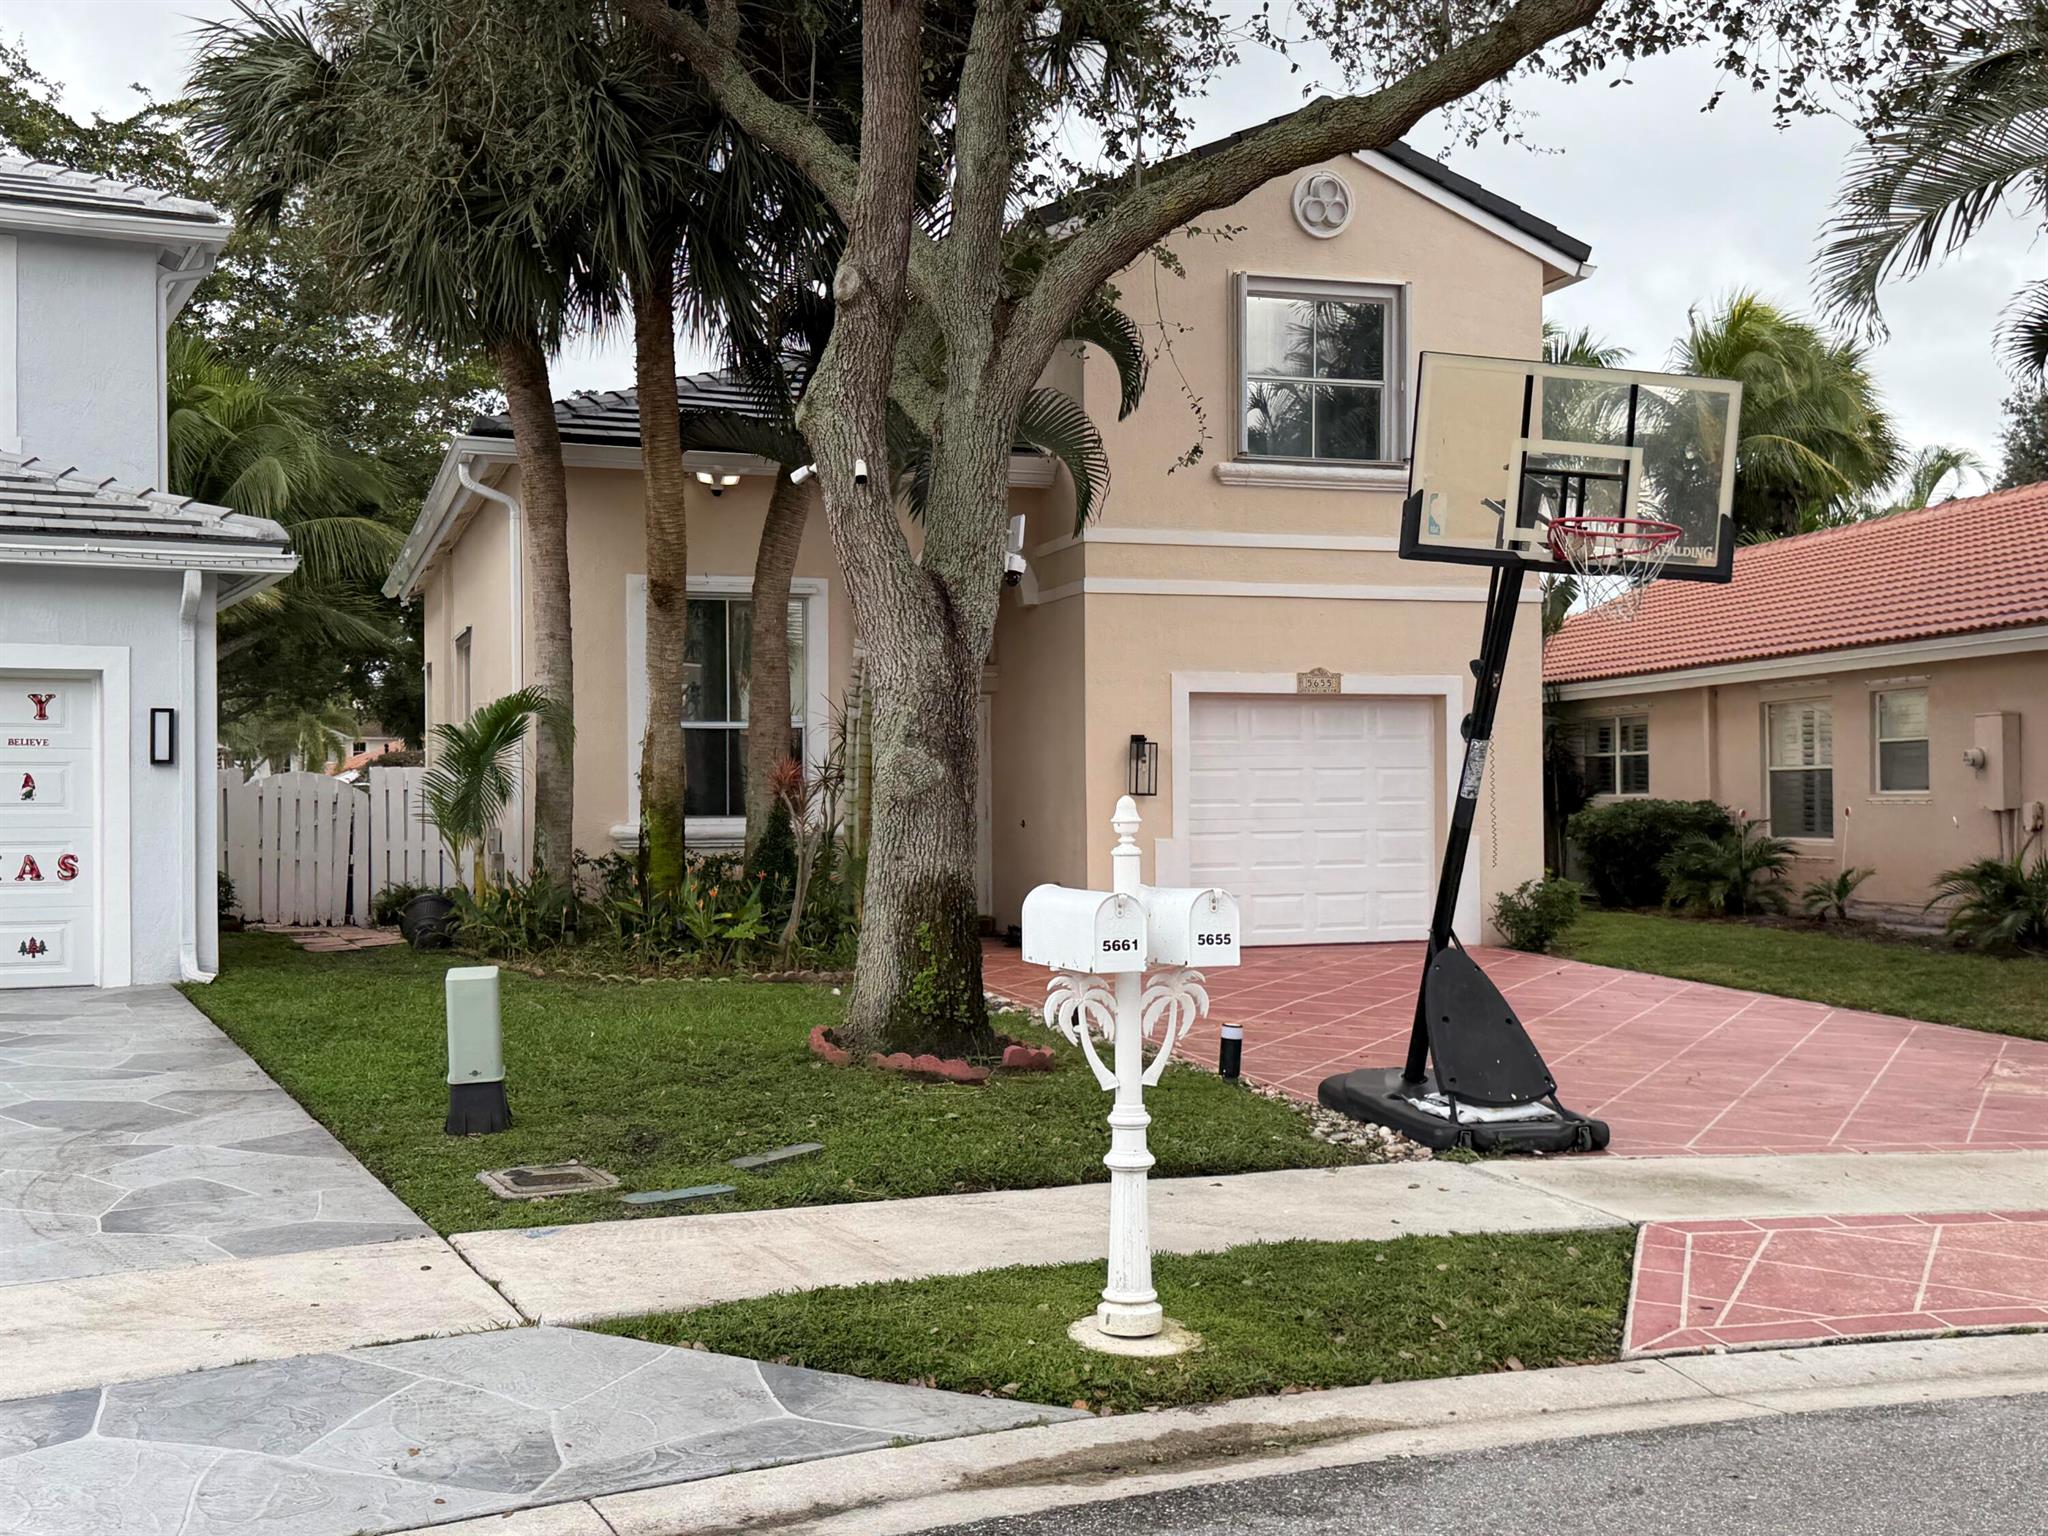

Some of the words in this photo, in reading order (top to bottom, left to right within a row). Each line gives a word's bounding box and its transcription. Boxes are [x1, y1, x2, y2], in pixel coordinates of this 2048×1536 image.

[1307, 679, 1332, 688] 5655
[27, 693, 56, 720] Y
[7, 738, 50, 747] BELIEVE
[0, 854, 79, 881] AS
[1102, 939, 1139, 952] 5661
[1197, 933, 1232, 946] 5655
